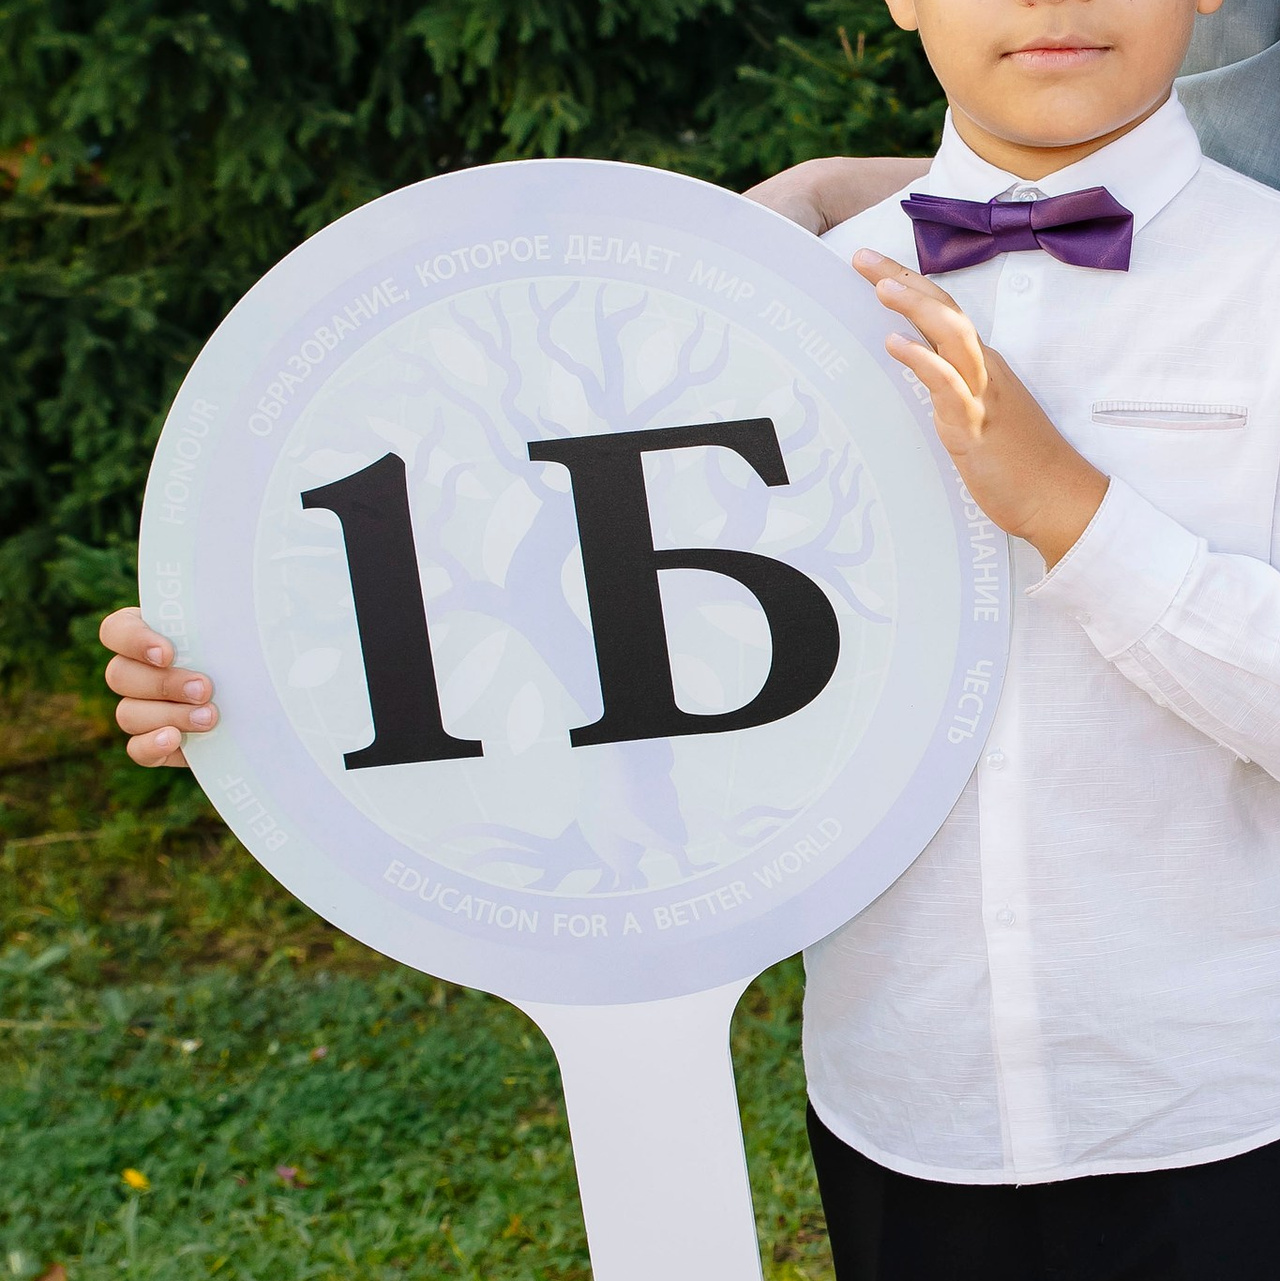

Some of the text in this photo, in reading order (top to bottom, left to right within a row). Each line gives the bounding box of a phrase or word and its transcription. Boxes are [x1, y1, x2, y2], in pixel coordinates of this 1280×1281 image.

[248, 235, 850, 437] ОБРАЗОВАНИЕ, КОТОРОЕ ДЕЛАЕТ МИР ЛУЧШЕ
[159, 398, 219, 525] HONOUR
[300, 417, 842, 771] 1Б
[947, 660, 994, 745] ЧЕСТЬ
[217, 773, 289, 852] BELIEF
[383, 817, 843, 938] EDUCATION FOR A BETTER WORLD
